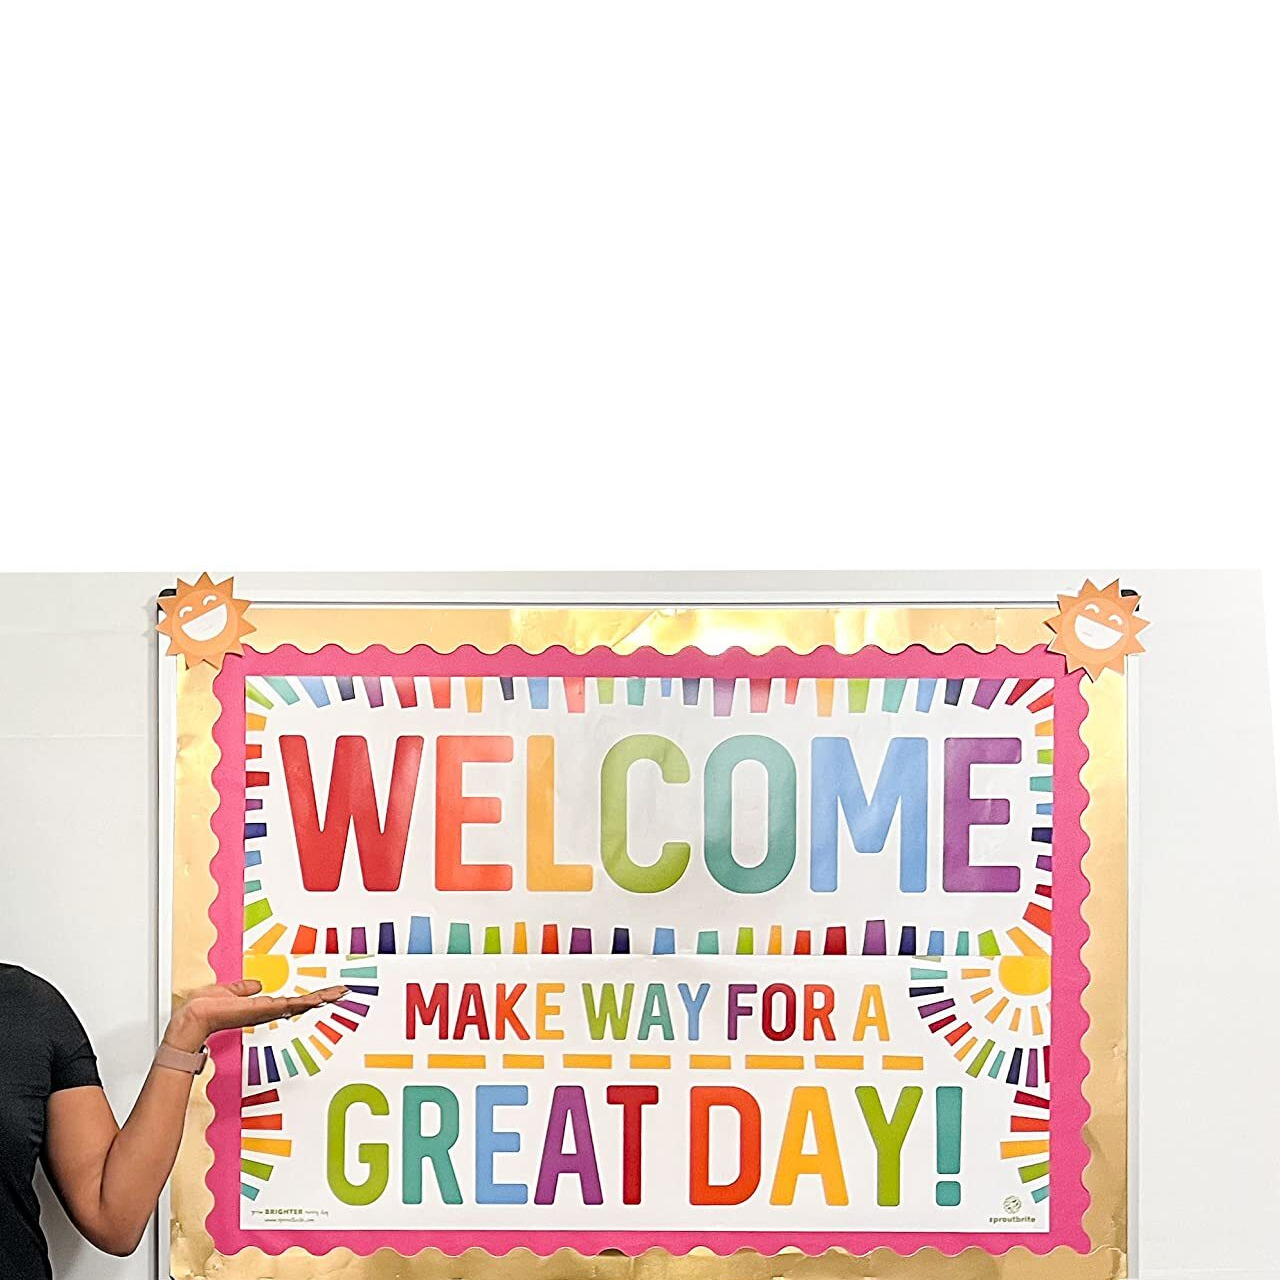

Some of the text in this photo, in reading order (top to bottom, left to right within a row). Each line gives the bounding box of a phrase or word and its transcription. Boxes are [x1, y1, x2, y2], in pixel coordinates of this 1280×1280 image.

[278, 733, 1023, 894] WELCOME
[405, 982, 890, 1042] MAKE WAY FOR A
[327, 1082, 963, 1207] GREAT DAY!
[988, 1216, 1036, 1224] sproutbrite
